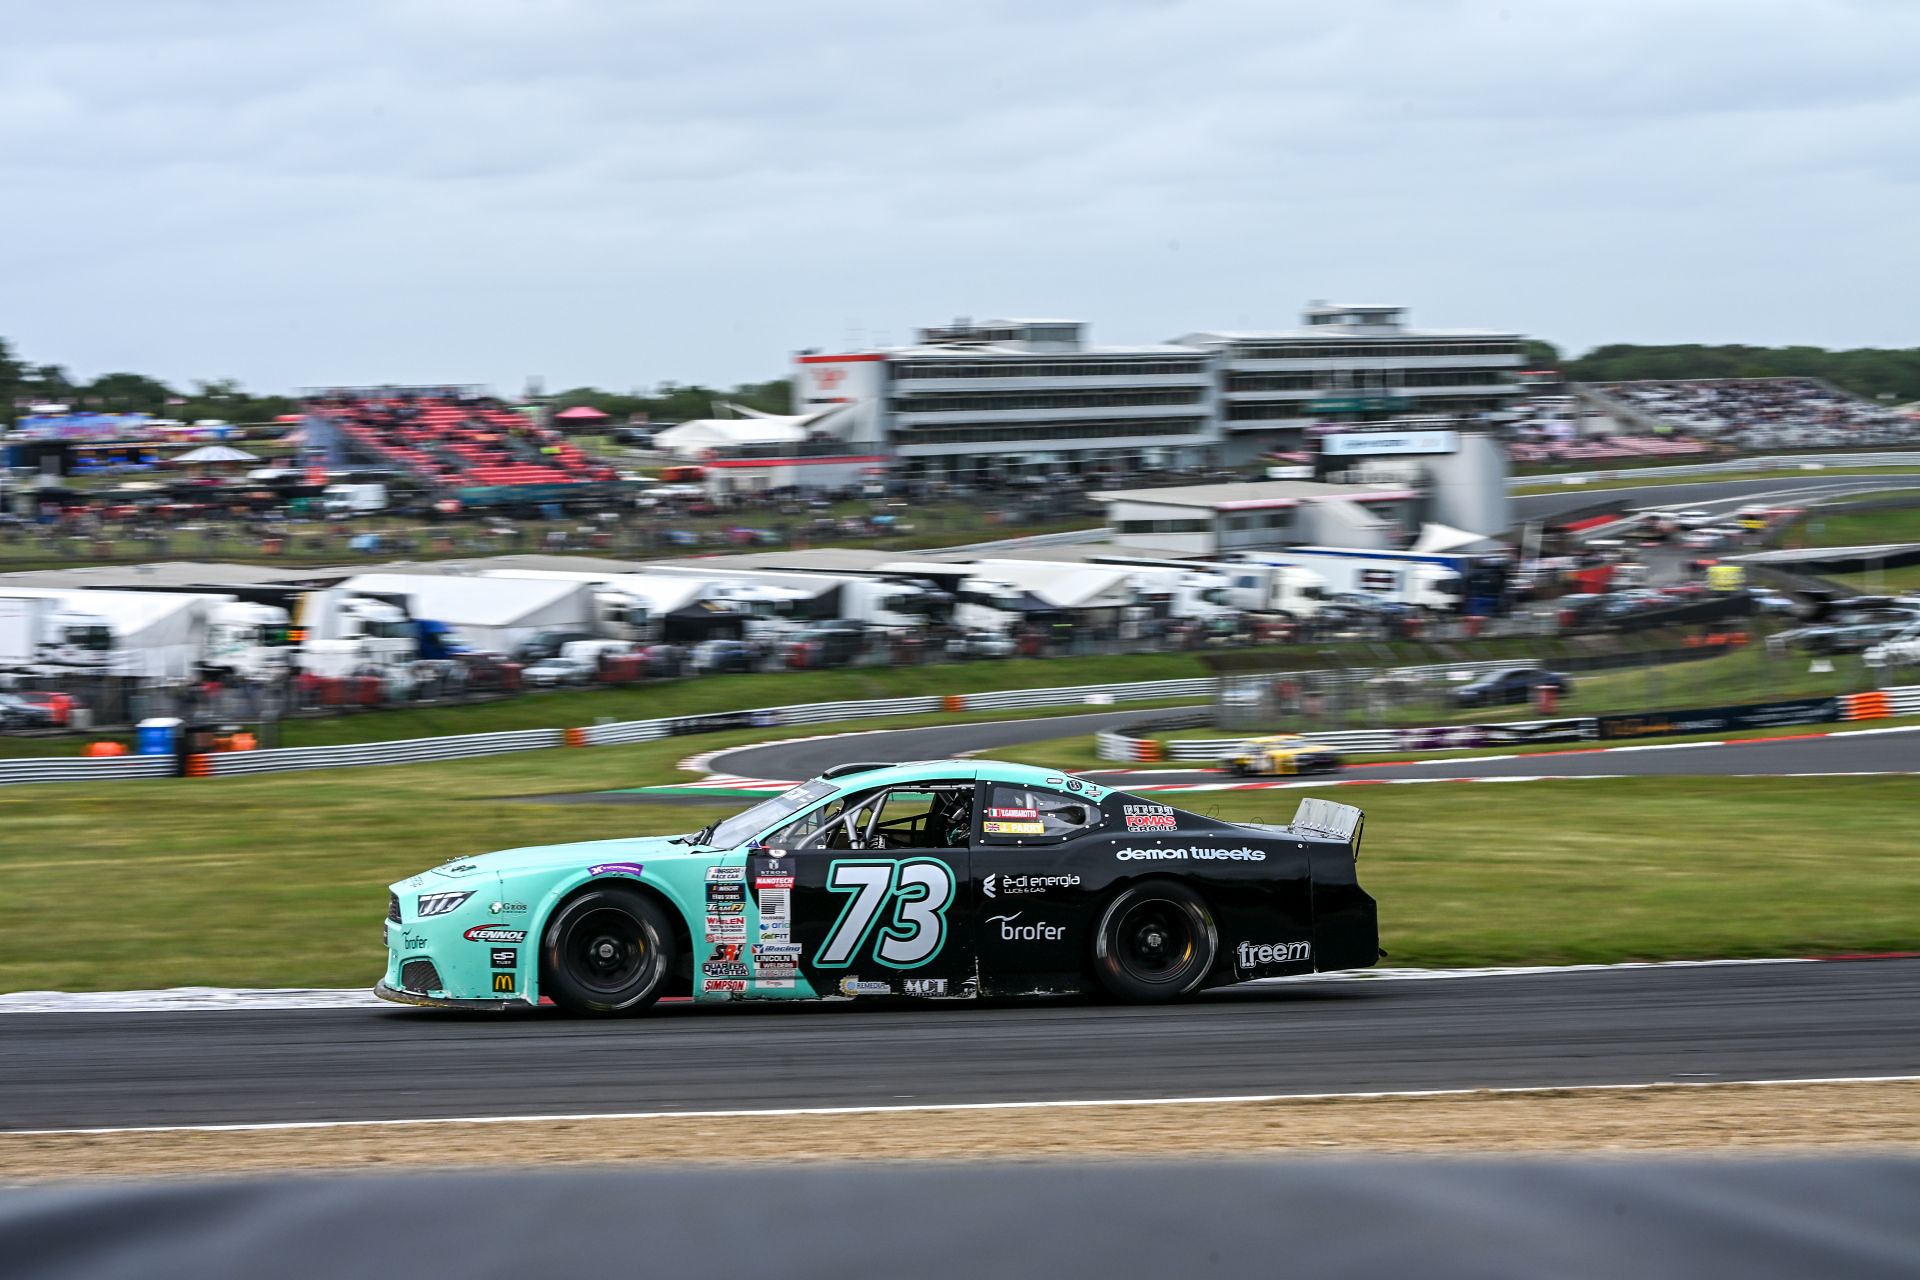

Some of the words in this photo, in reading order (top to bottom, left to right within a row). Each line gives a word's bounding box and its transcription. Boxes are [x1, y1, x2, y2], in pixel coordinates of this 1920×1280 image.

[1126, 815, 1176, 826] FOMAS
[1116, 847, 1188, 861] demon
[1190, 846, 1266, 861] tweeks
[756, 876, 794, 884] NANOTECH
[1030, 873, 1081, 888] energia
[812, 856, 956, 969] 73
[706, 917, 744, 925] WHELEN
[468, 930, 525, 939] KENNOL
[1001, 921, 1066, 940] brofer
[405, 935, 428, 949] brofer
[1239, 942, 1309, 967] freem
[705, 980, 745, 991] SIMPSON
